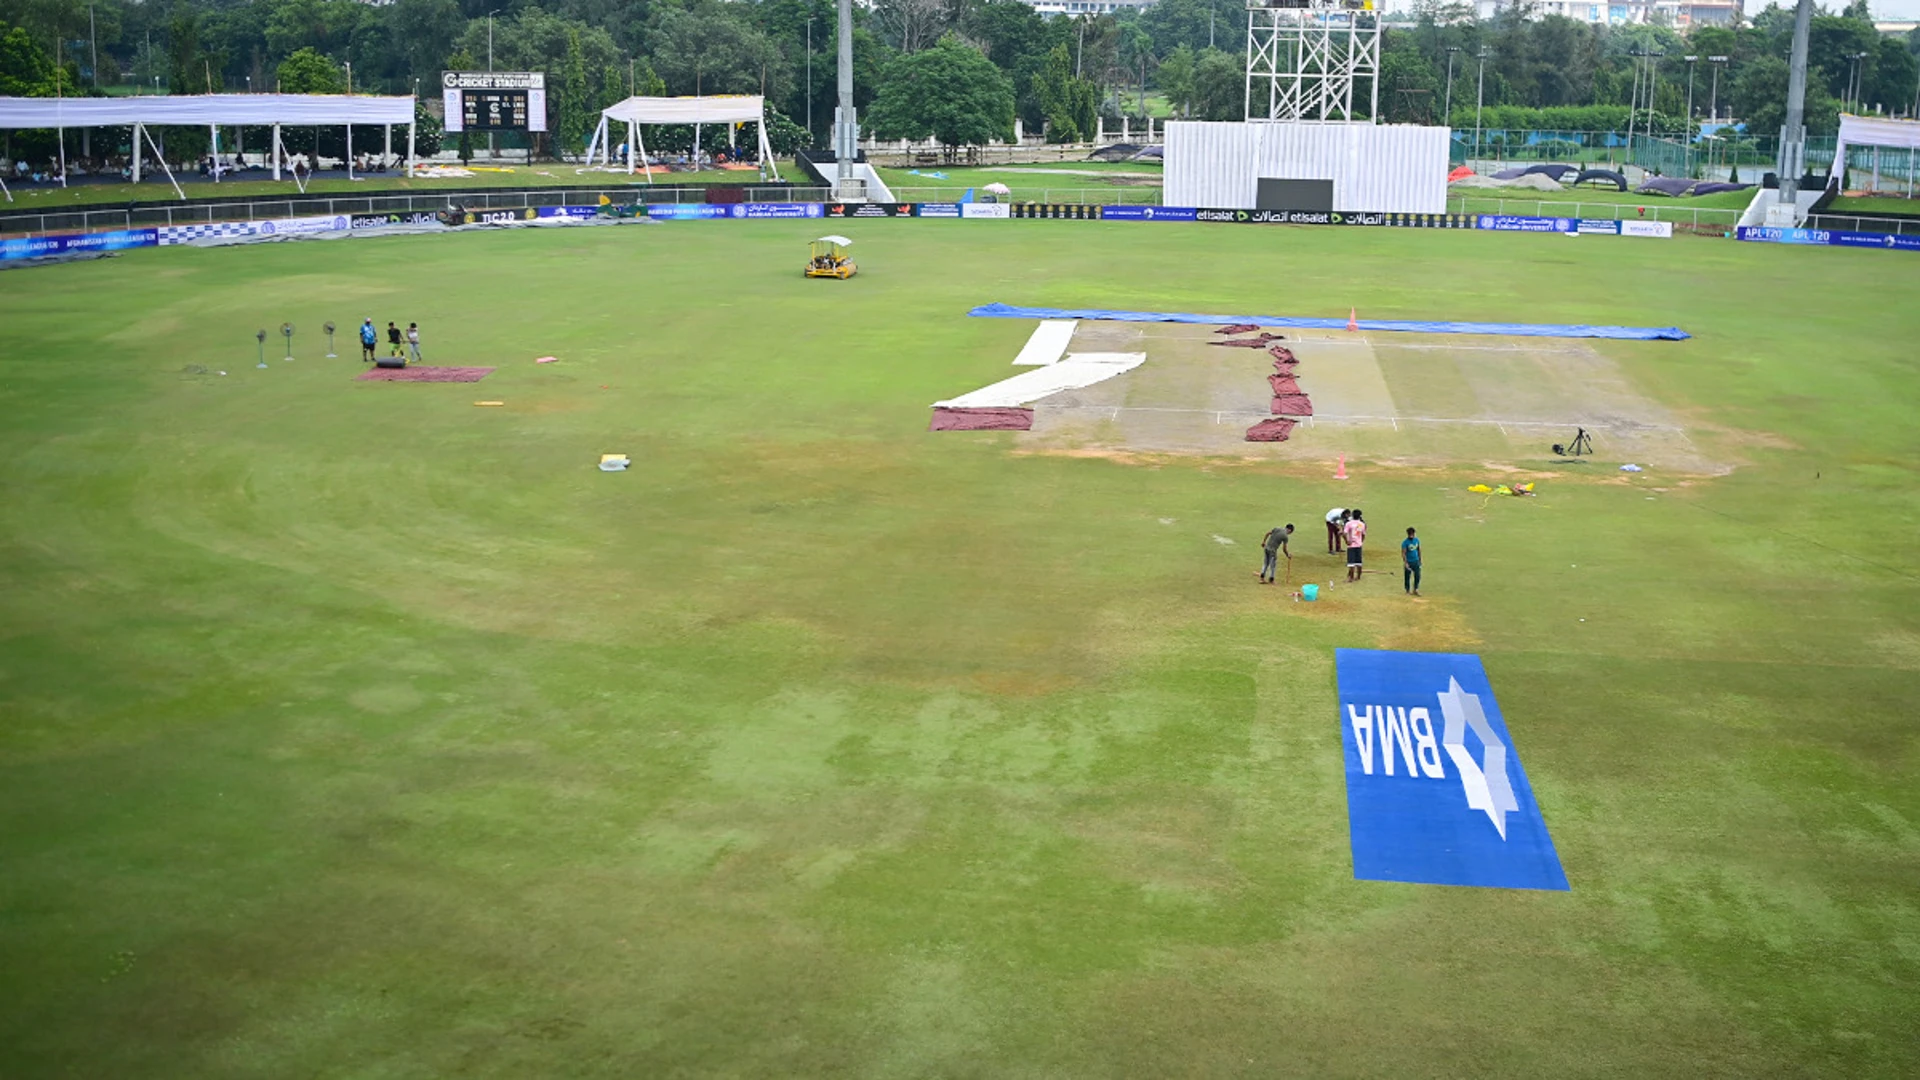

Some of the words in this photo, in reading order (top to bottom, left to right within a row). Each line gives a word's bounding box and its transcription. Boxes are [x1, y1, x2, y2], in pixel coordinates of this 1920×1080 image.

[458, 78, 493, 87] CRICKET
[494, 78, 531, 88] STADIUM
[1196, 210, 1234, 221] etisalat
[1252, 210, 1288, 222] اتصالات
[1290, 211, 1328, 223] etisalat
[1345, 212, 1382, 225] اتصالات
[1745, 228, 1762, 237] APL
[1766, 228, 1782, 238] T20
[1792, 230, 1809, 239] APL
[1813, 231, 1830, 240] T20
[1347, 704, 1445, 779] BMA
